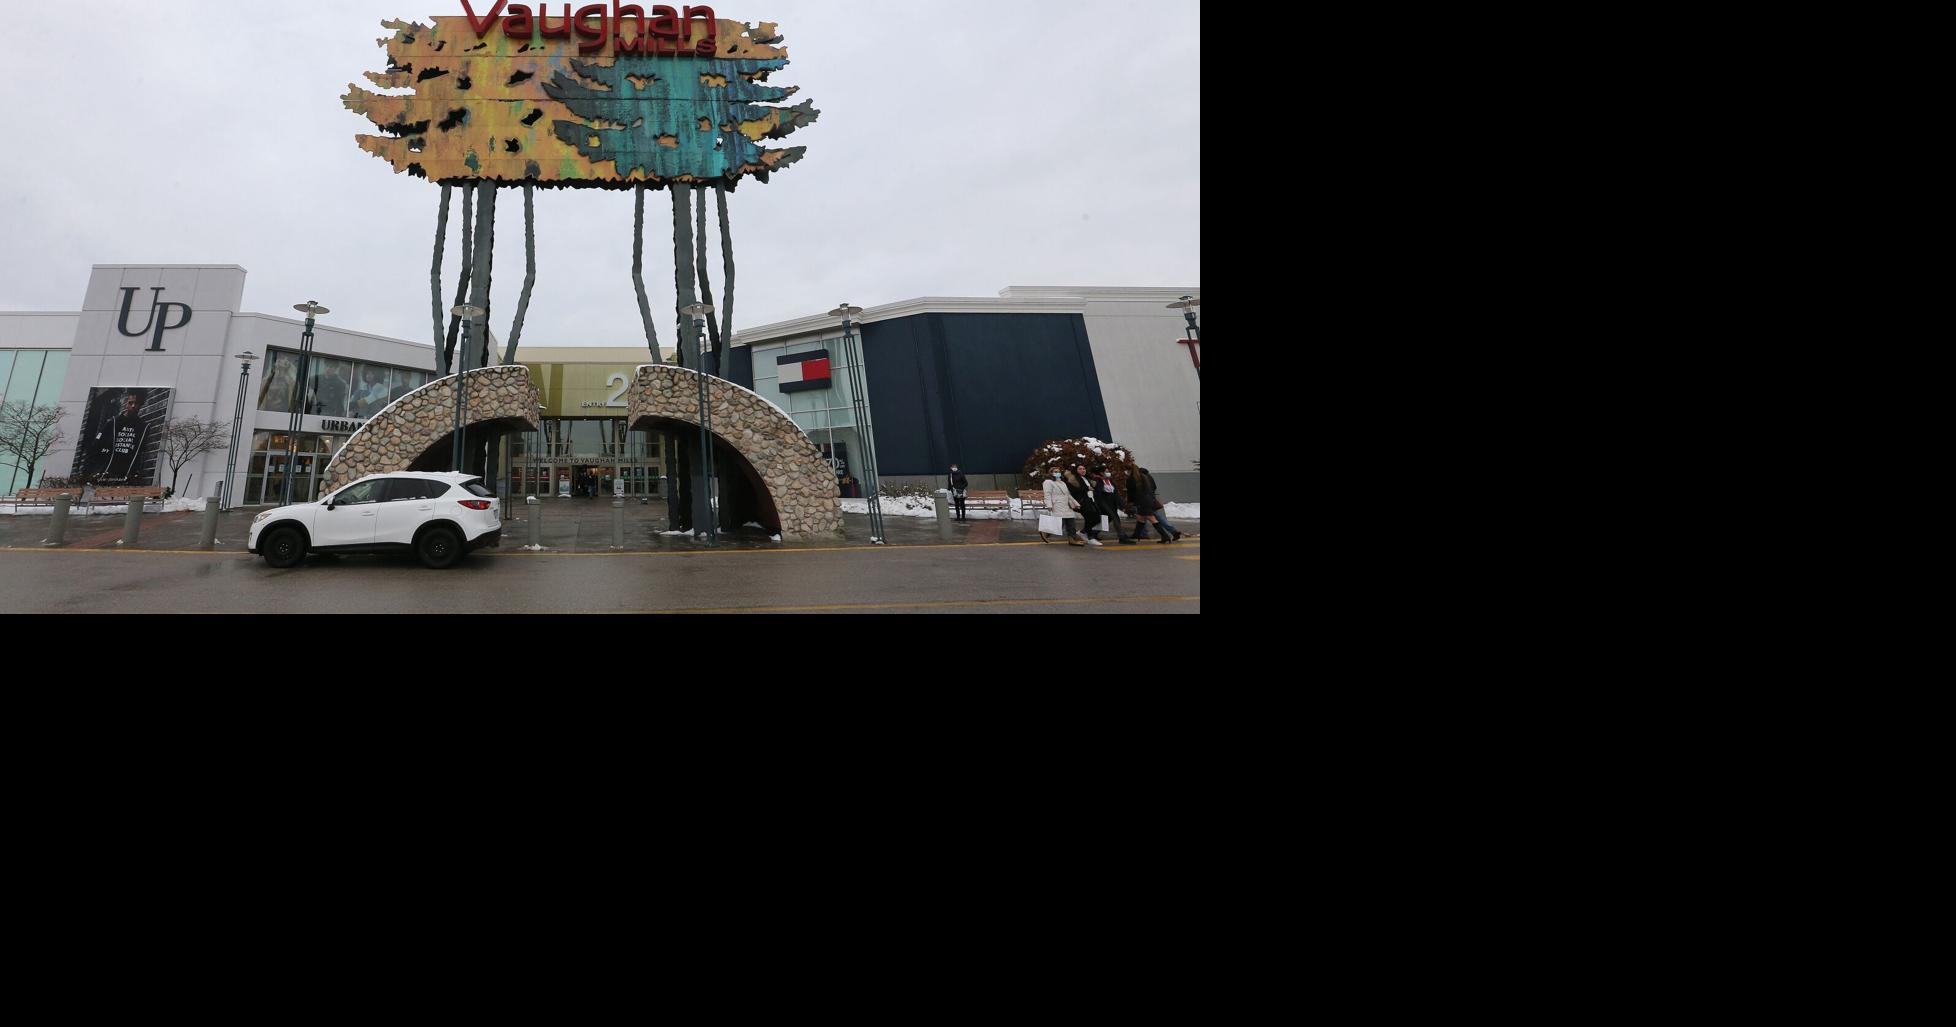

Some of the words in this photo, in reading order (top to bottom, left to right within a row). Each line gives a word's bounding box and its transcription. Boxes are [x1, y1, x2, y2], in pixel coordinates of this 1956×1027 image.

[461, 0, 716, 56] Vaughan
[614, 36, 717, 57] MILLS
[117, 286, 192, 351] UP
[606, 373, 628, 407] 2
